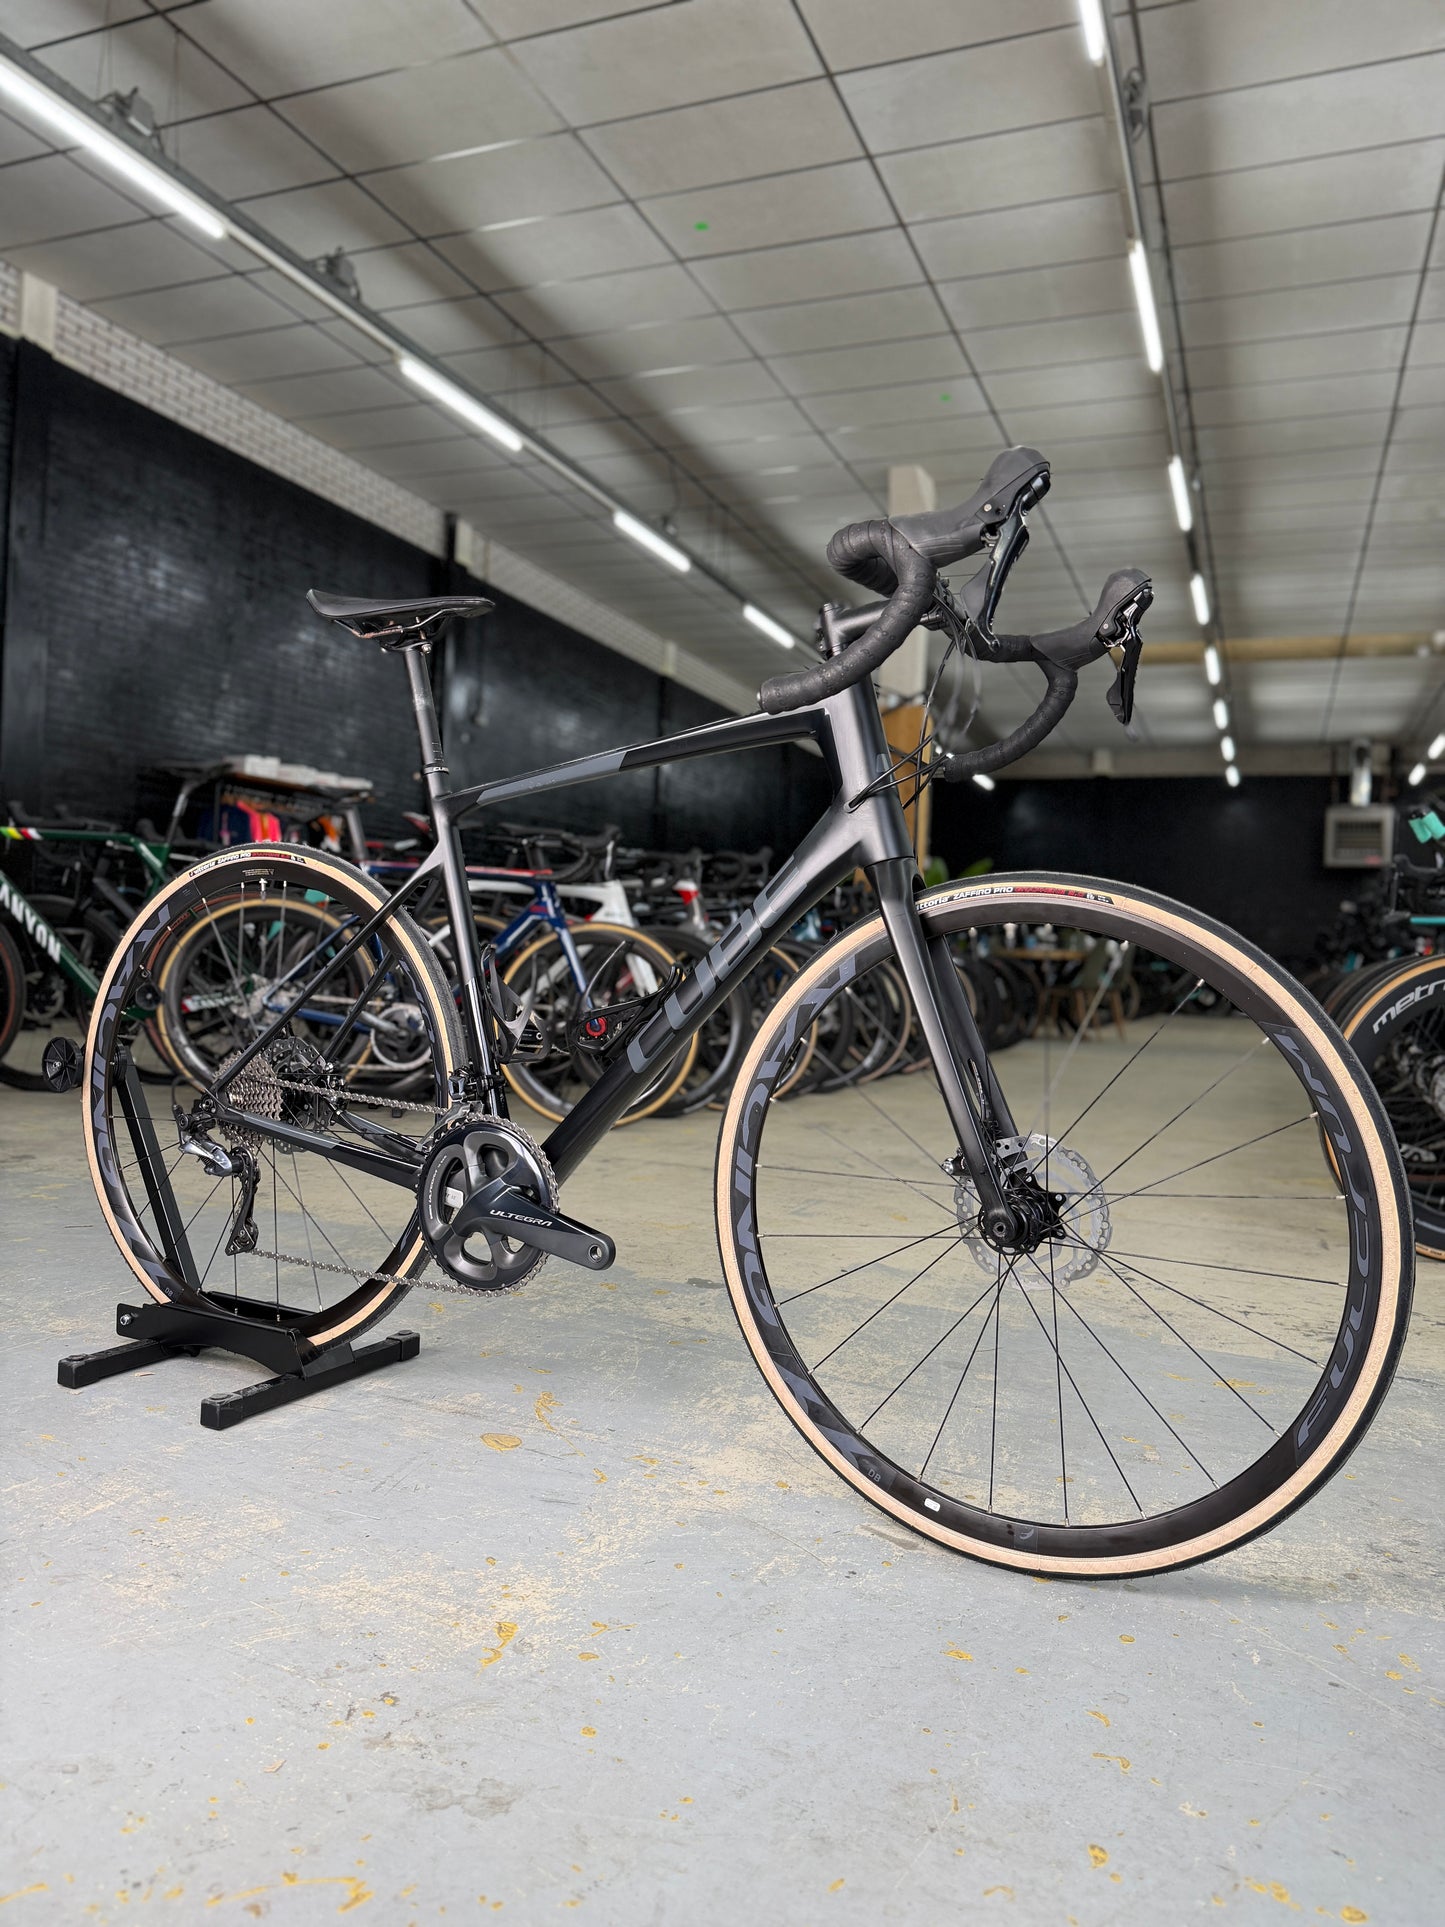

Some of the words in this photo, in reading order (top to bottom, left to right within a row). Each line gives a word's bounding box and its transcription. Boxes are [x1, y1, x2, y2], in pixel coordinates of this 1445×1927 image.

[0, 883, 61, 964] ANYON
[916, 896, 949, 911] ittoria
[953, 887, 992, 901] ZAFFIRO
[993, 886, 1014, 894] PRO
[626, 854, 808, 1074] CUBE
[1372, 979, 1445, 1035] metr
[735, 951, 858, 1328] RACING
[489, 1208, 553, 1227] ULTEGRA
[867, 1467, 882, 1483] DB
